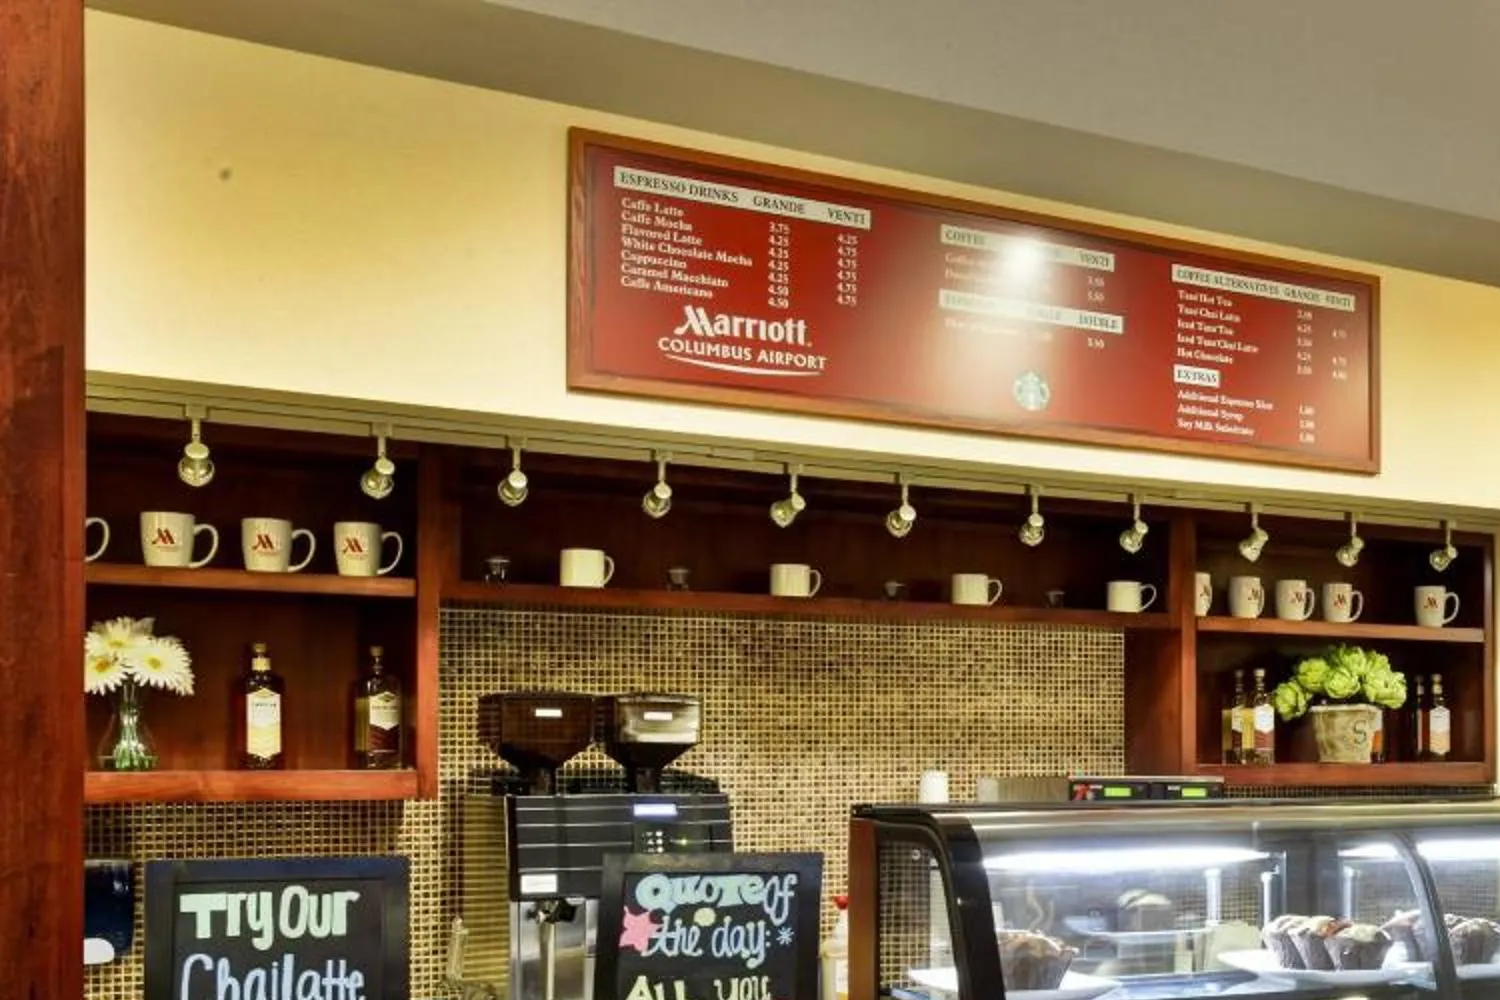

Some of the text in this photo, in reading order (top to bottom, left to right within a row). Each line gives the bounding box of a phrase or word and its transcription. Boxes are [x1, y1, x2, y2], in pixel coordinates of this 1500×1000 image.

[620, 171, 866, 225] ESPRESSO DRINKS GRANDE VENTI
[655, 203, 684, 217] Latte
[621, 223, 671, 240] Flavored
[673, 231, 703, 246] Latte
[654, 216, 693, 231] Mocha
[621, 236, 656, 251] White
[658, 242, 713, 260] Chocolate
[715, 251, 753, 267] Mocha
[621, 262, 669, 279] Caramel
[671, 269, 729, 288] Macchiato
[653, 280, 714, 299] Americano
[673, 304, 808, 346] Marriott
[658, 336, 828, 370] COLUMBUS AIRPORT
[1177, 368, 1218, 385] EXTRAS
[1352, 720, 1370, 746] S
[763, 873, 799, 926] of
[179, 885, 361, 951] Try Our
[641, 916, 704, 958] the
